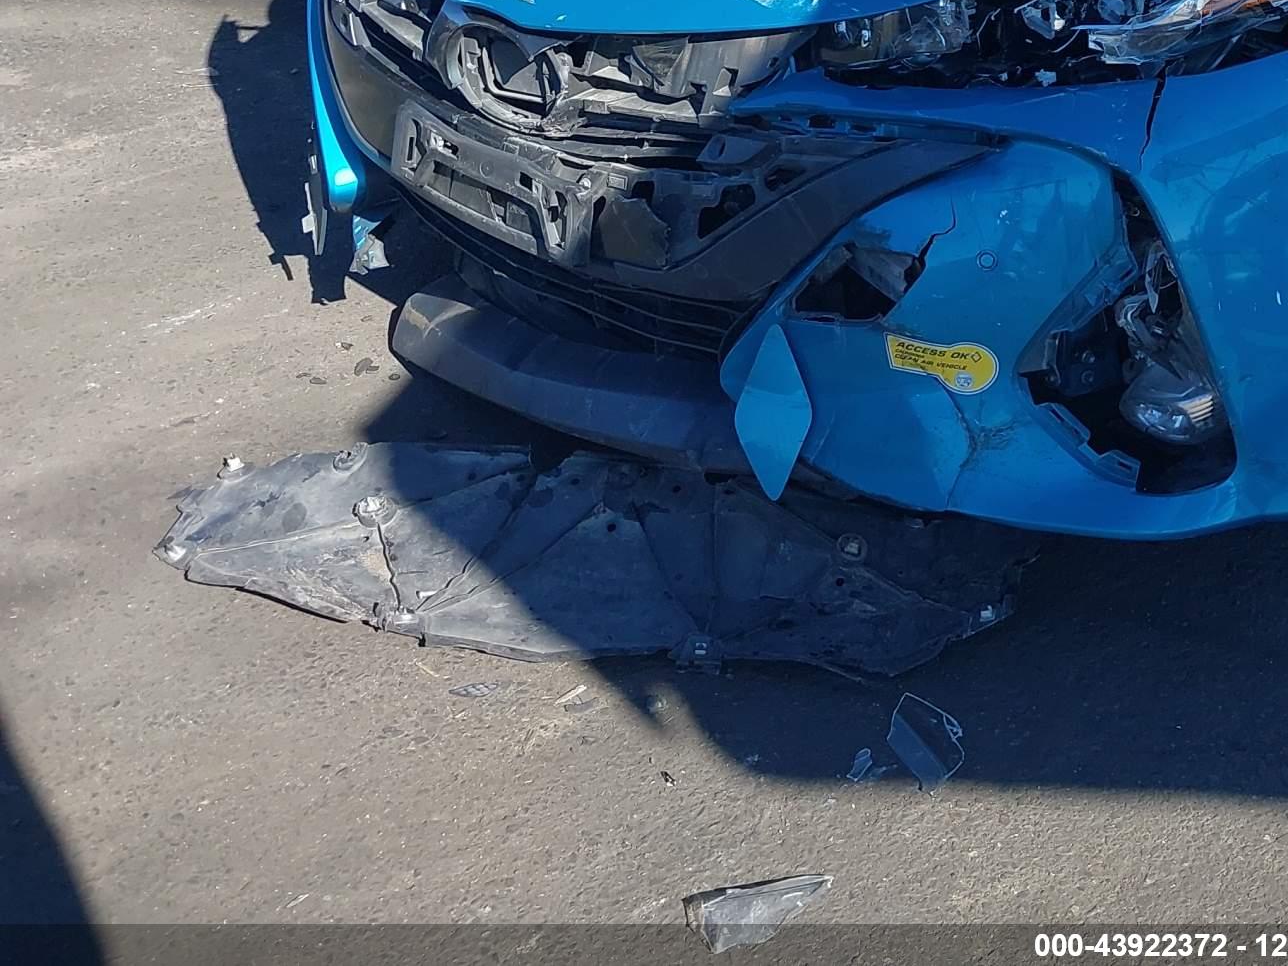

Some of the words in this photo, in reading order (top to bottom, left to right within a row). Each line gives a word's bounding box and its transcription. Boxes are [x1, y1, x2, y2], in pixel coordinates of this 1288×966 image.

[896, 341, 947, 357] ACCESS
[951, 351, 970, 360] OK
[894, 353, 919, 363] CLEAN
[936, 361, 967, 371] VEHICLE
